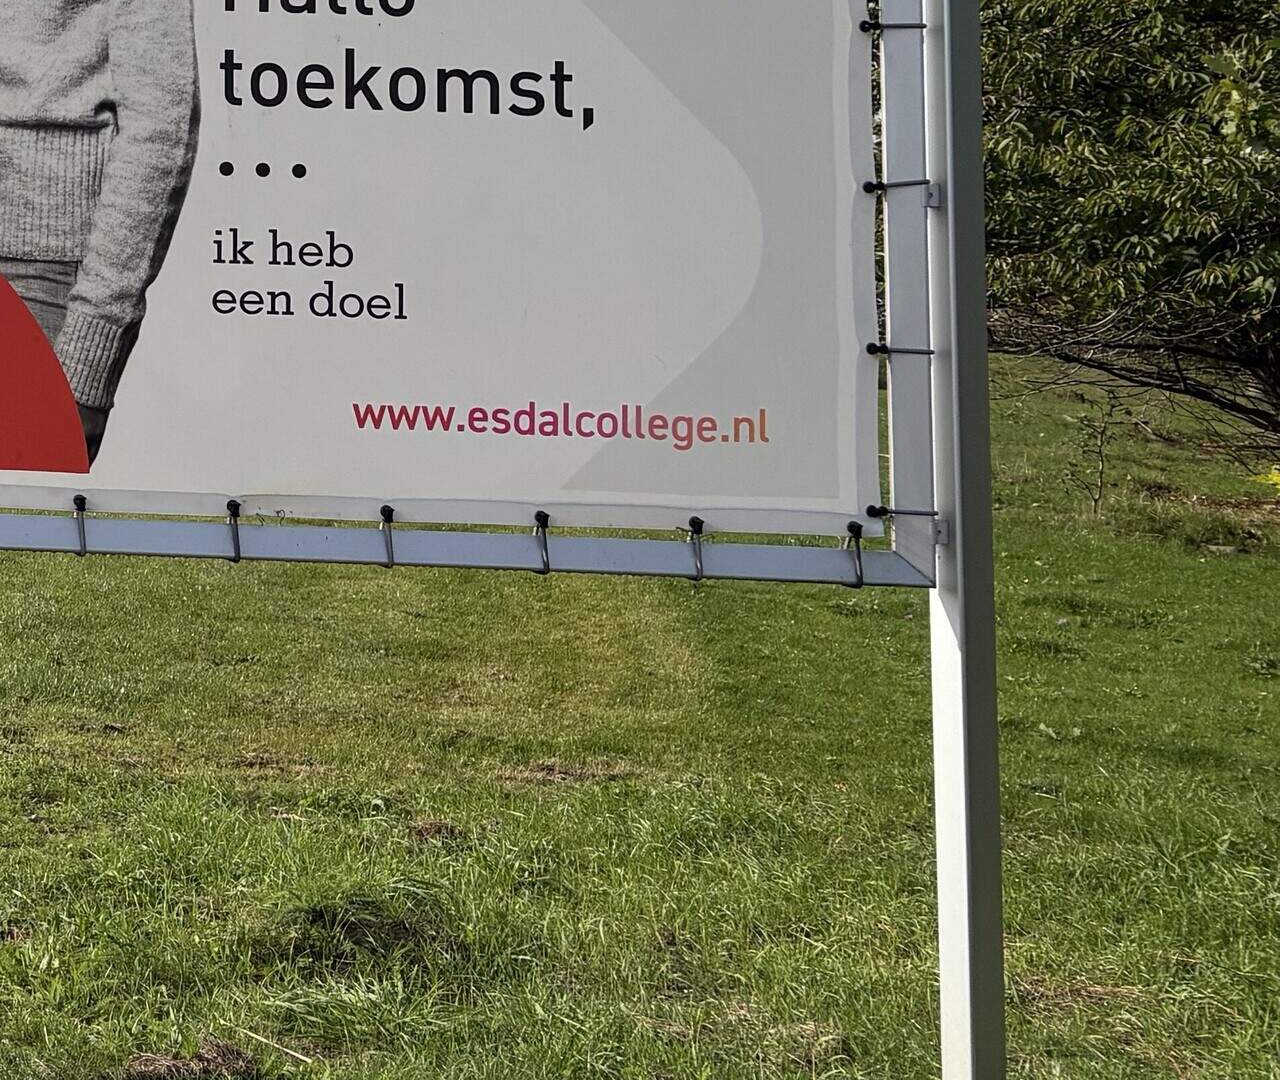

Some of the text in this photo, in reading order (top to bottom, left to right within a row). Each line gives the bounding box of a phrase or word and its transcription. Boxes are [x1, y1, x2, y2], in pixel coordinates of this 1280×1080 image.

[219, 48, 594, 132] toekomst,
[211, 227, 355, 268] ik heb
[211, 280, 408, 320] een doel
[351, 401, 770, 451] www.esdalcollege.nl
